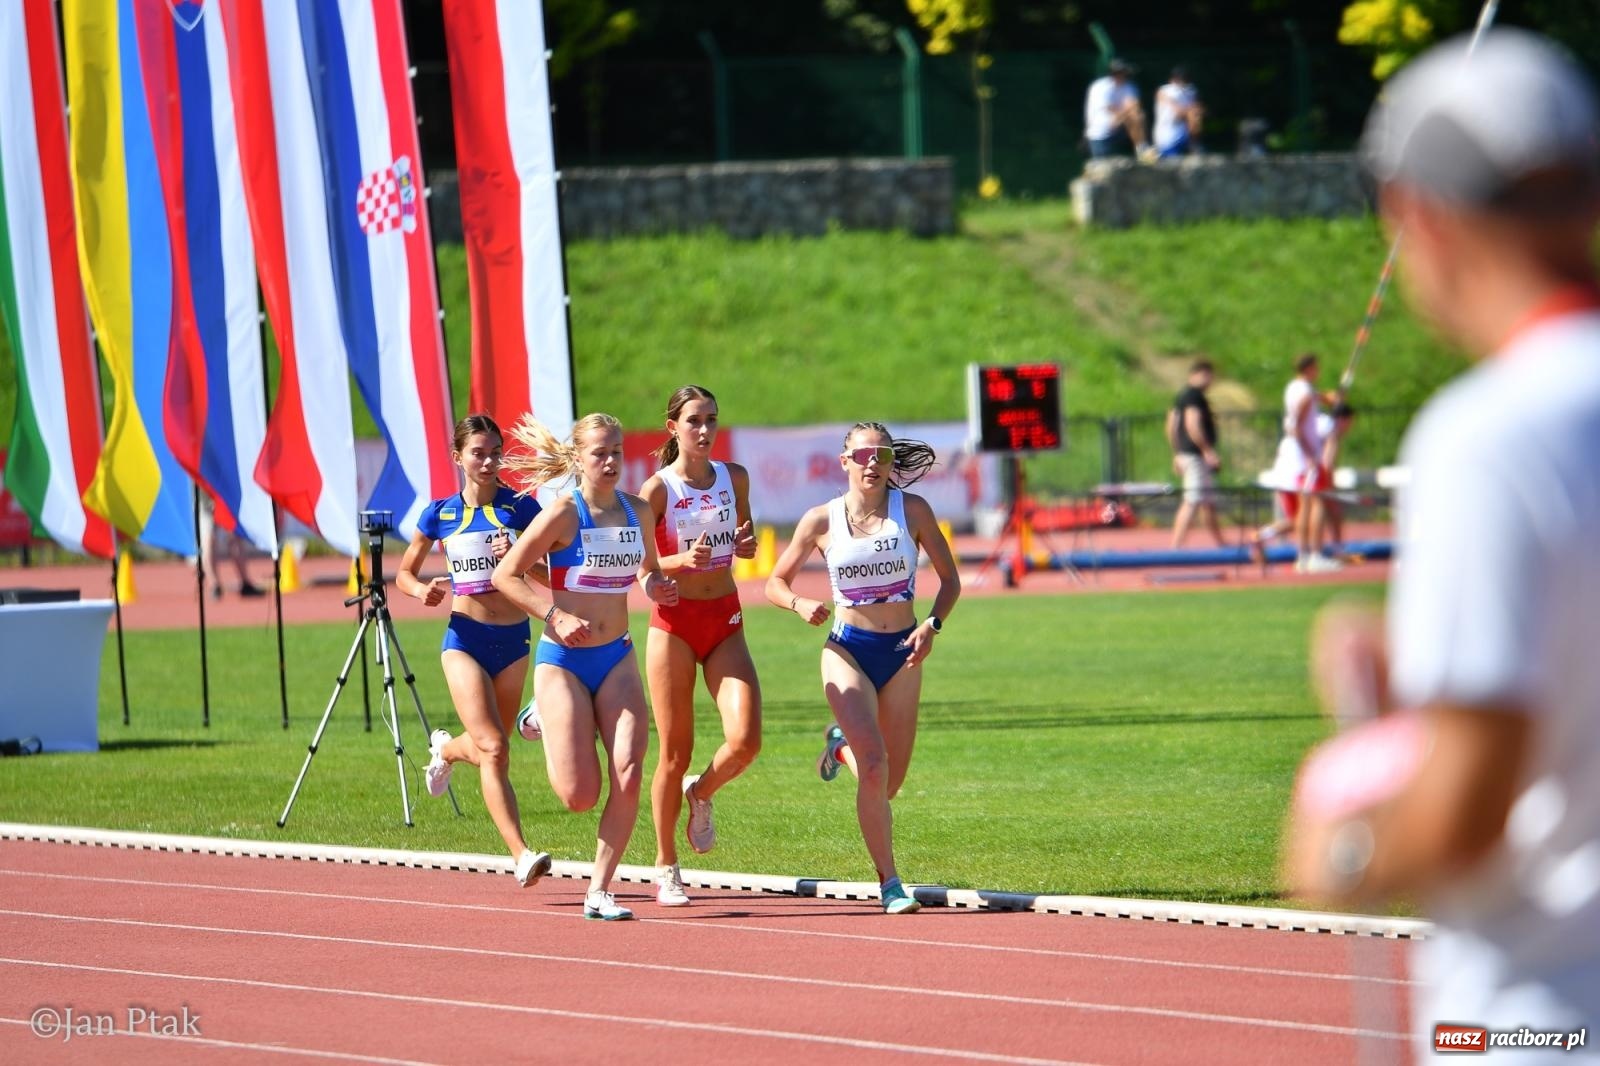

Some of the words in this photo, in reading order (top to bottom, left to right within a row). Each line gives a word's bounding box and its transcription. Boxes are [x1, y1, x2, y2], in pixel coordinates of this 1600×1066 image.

[718, 508, 731, 523] 17
[618, 531, 637, 543] 117
[874, 537, 899, 552] 317
[586, 550, 642, 568] ŠTEFANOVÁ
[838, 556, 906, 580] POPOVICOVÁ
